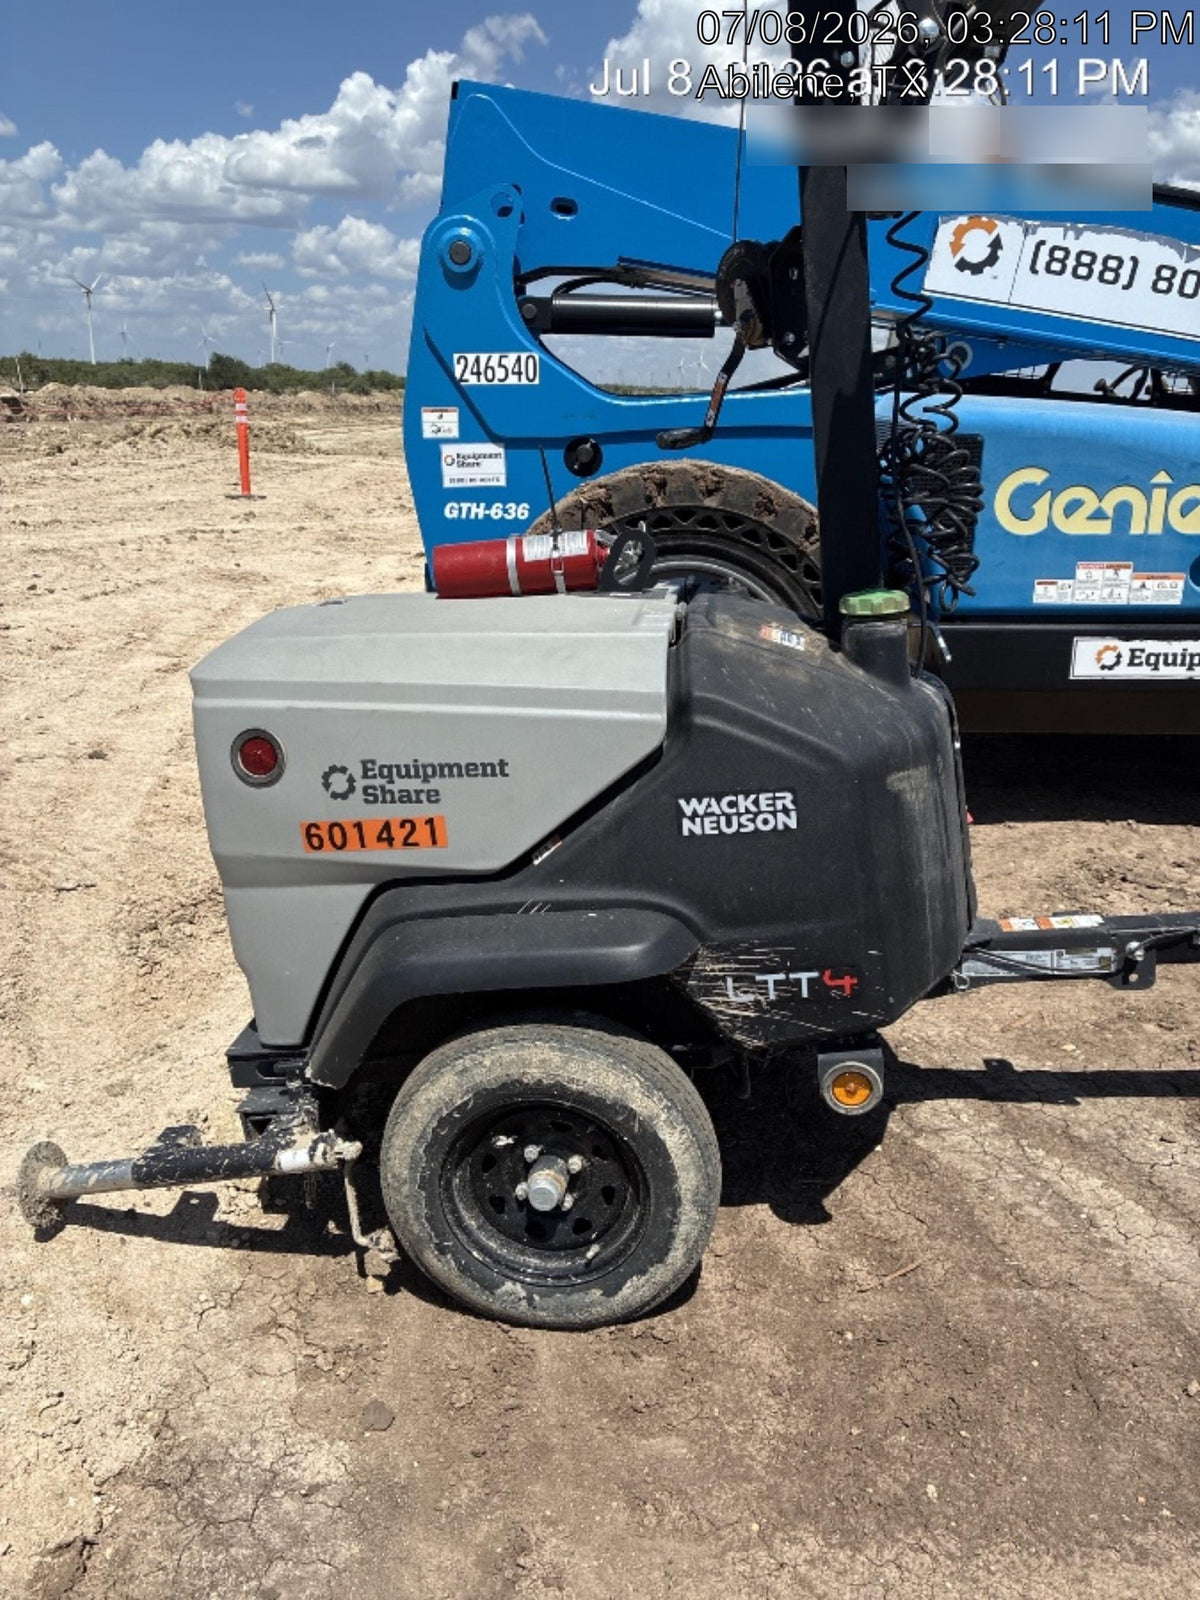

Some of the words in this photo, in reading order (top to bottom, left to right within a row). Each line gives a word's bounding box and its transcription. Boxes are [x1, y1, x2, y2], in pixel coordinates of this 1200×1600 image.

[1029, 240, 1139, 290] (888)
[1151, 264, 1200, 299] 80
[456, 354, 538, 384] 246540
[443, 501, 530, 520] GTH-636
[360, 758, 509, 785] Equipment
[361, 784, 441, 804] Share
[678, 791, 797, 816] WACKER
[304, 817, 438, 851] 601421
[681, 810, 798, 837] NEUSON
[726, 969, 858, 1001] LTT4
